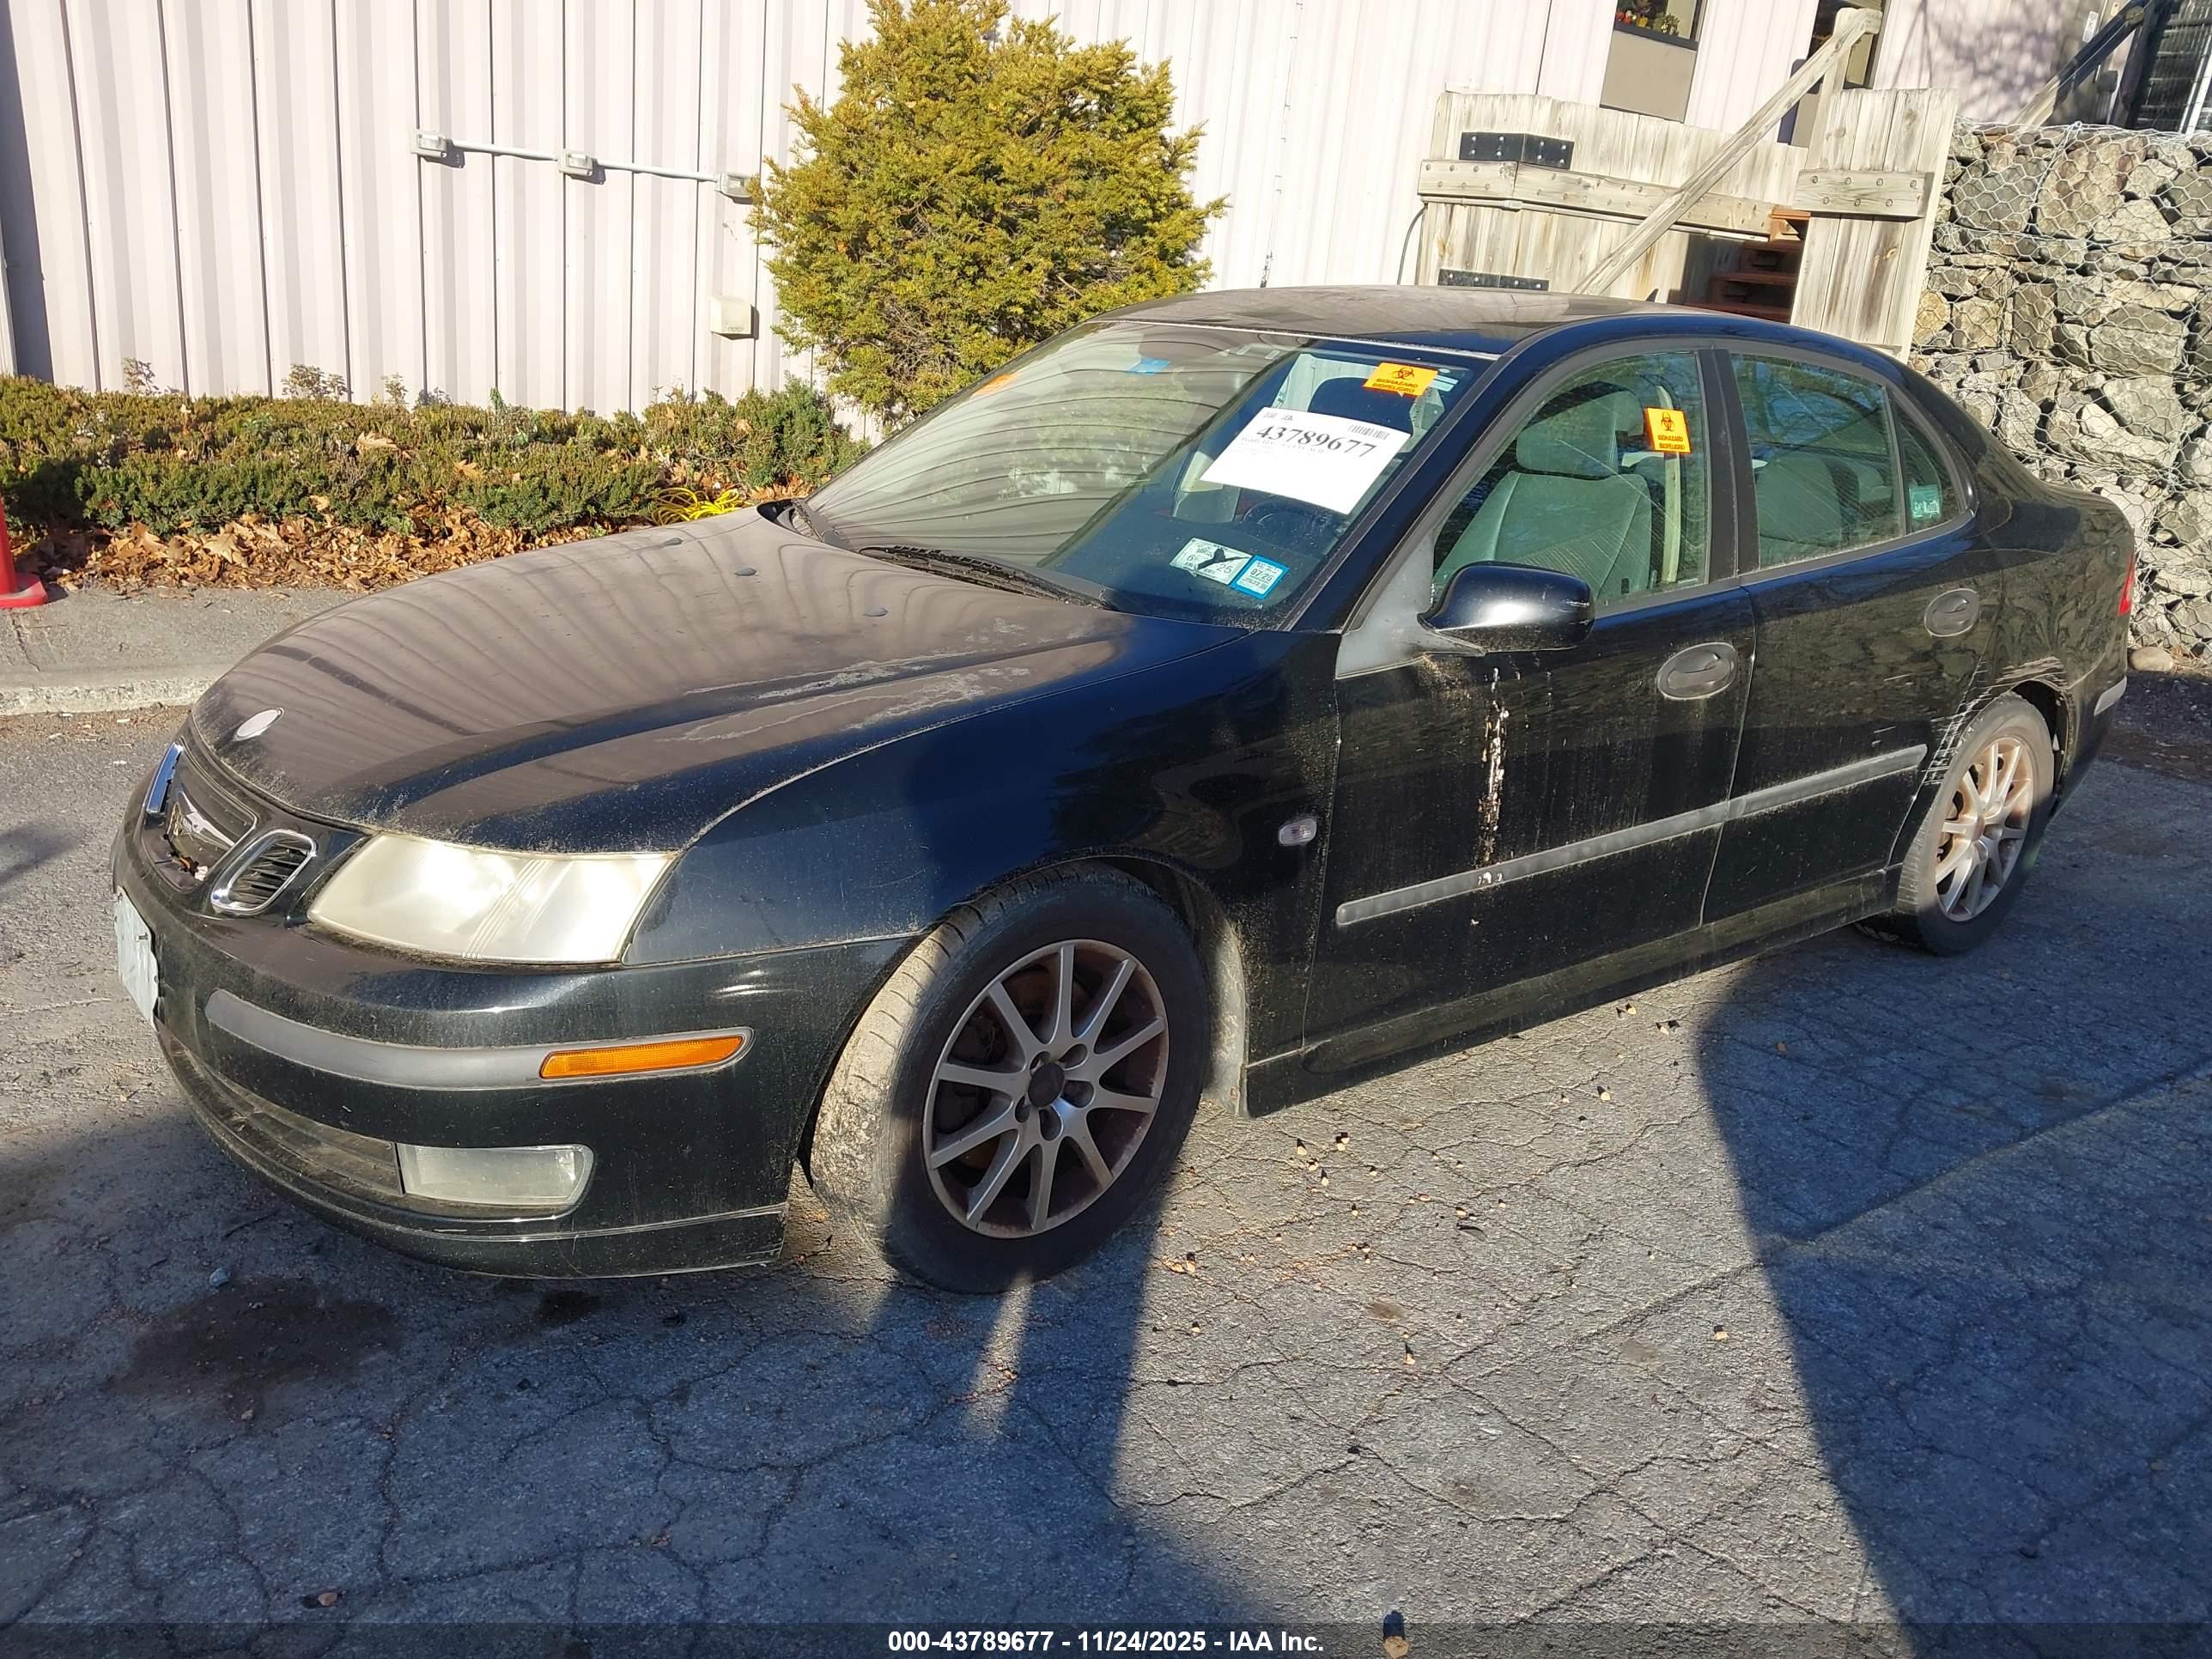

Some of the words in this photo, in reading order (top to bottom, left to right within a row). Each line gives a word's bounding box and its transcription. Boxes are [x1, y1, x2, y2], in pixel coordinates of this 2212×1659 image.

[1371, 383, 1416, 392] BIOPELIGRO
[1376, 378, 1419, 388] BIOHAZARD
[1256, 425, 1377, 458] 43789677
